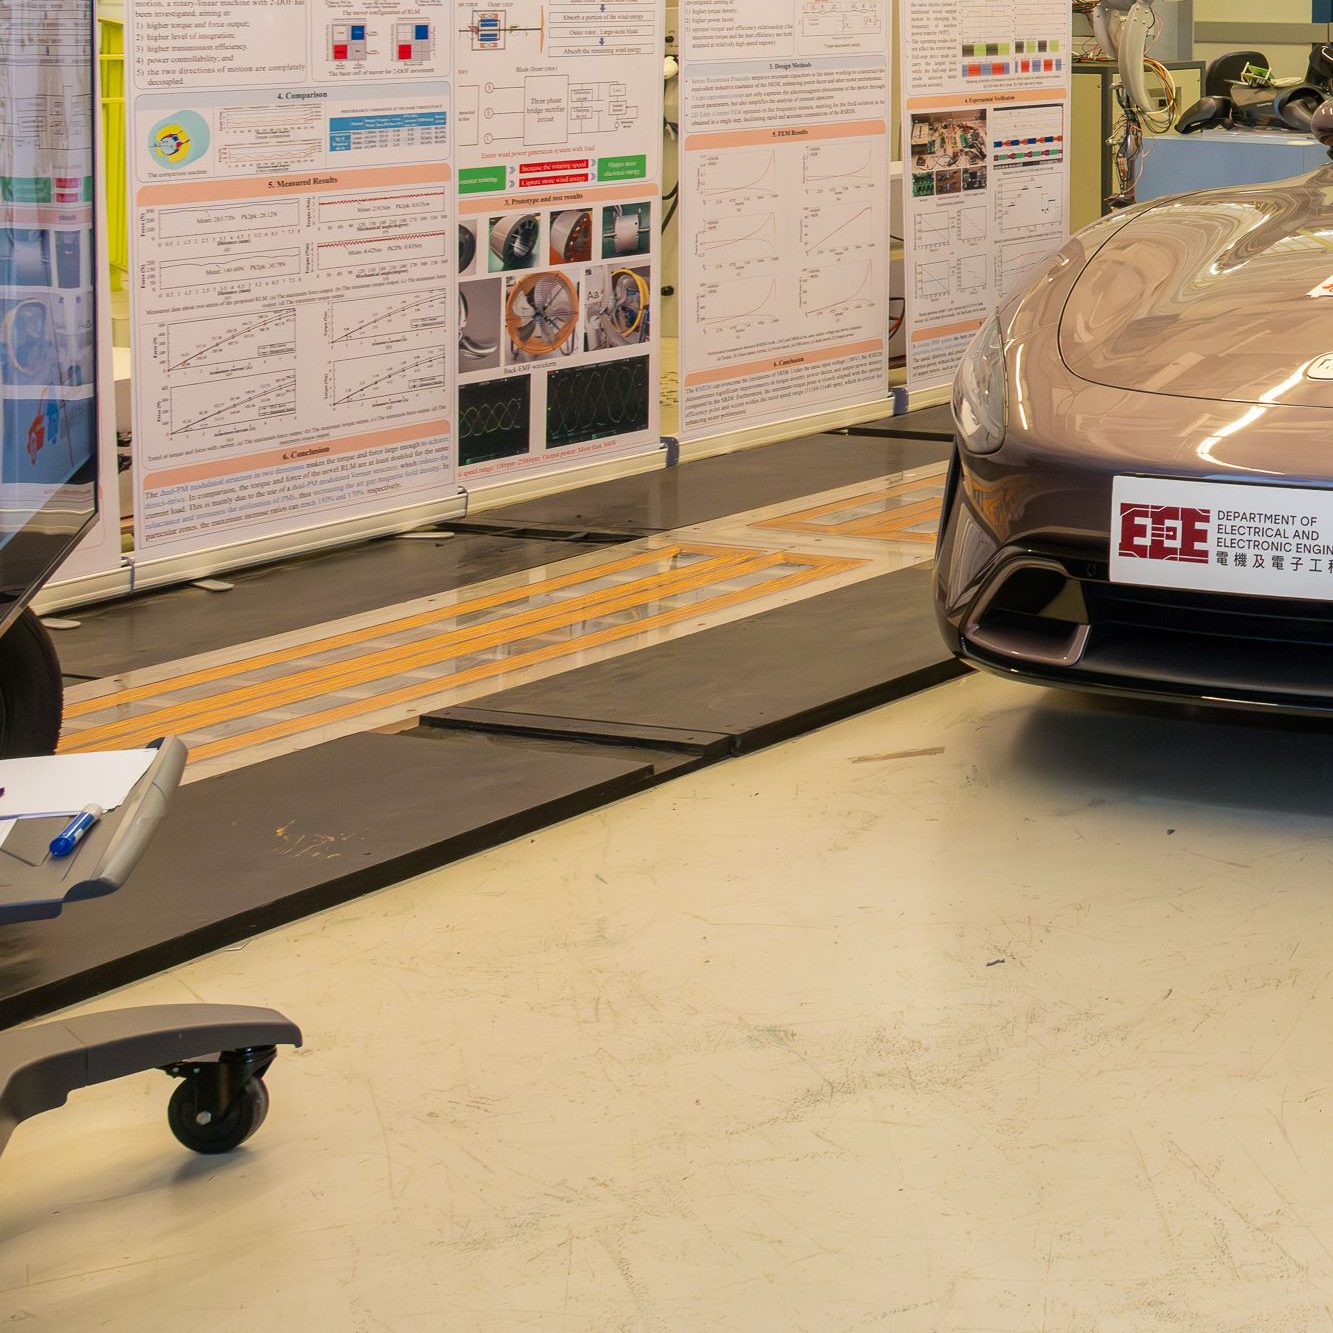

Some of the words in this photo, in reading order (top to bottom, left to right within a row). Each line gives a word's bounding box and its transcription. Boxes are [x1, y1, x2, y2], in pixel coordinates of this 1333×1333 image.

[285, 91, 328, 101] Comparison
[268, 181, 275, 189] 5.
[277, 178, 311, 188] Measured
[313, 176, 338, 185] Results
[587, 291, 602, 301] Aa
[1217, 510, 1297, 525] DEPARTMENT
[1300, 516, 1317, 527] OF
[1118, 502, 1211, 564] EEE
[1217, 524, 1289, 539] ELECTRICAL
[1293, 530, 1319, 541] AND
[1217, 537, 1292, 553] ELECTRONIC
